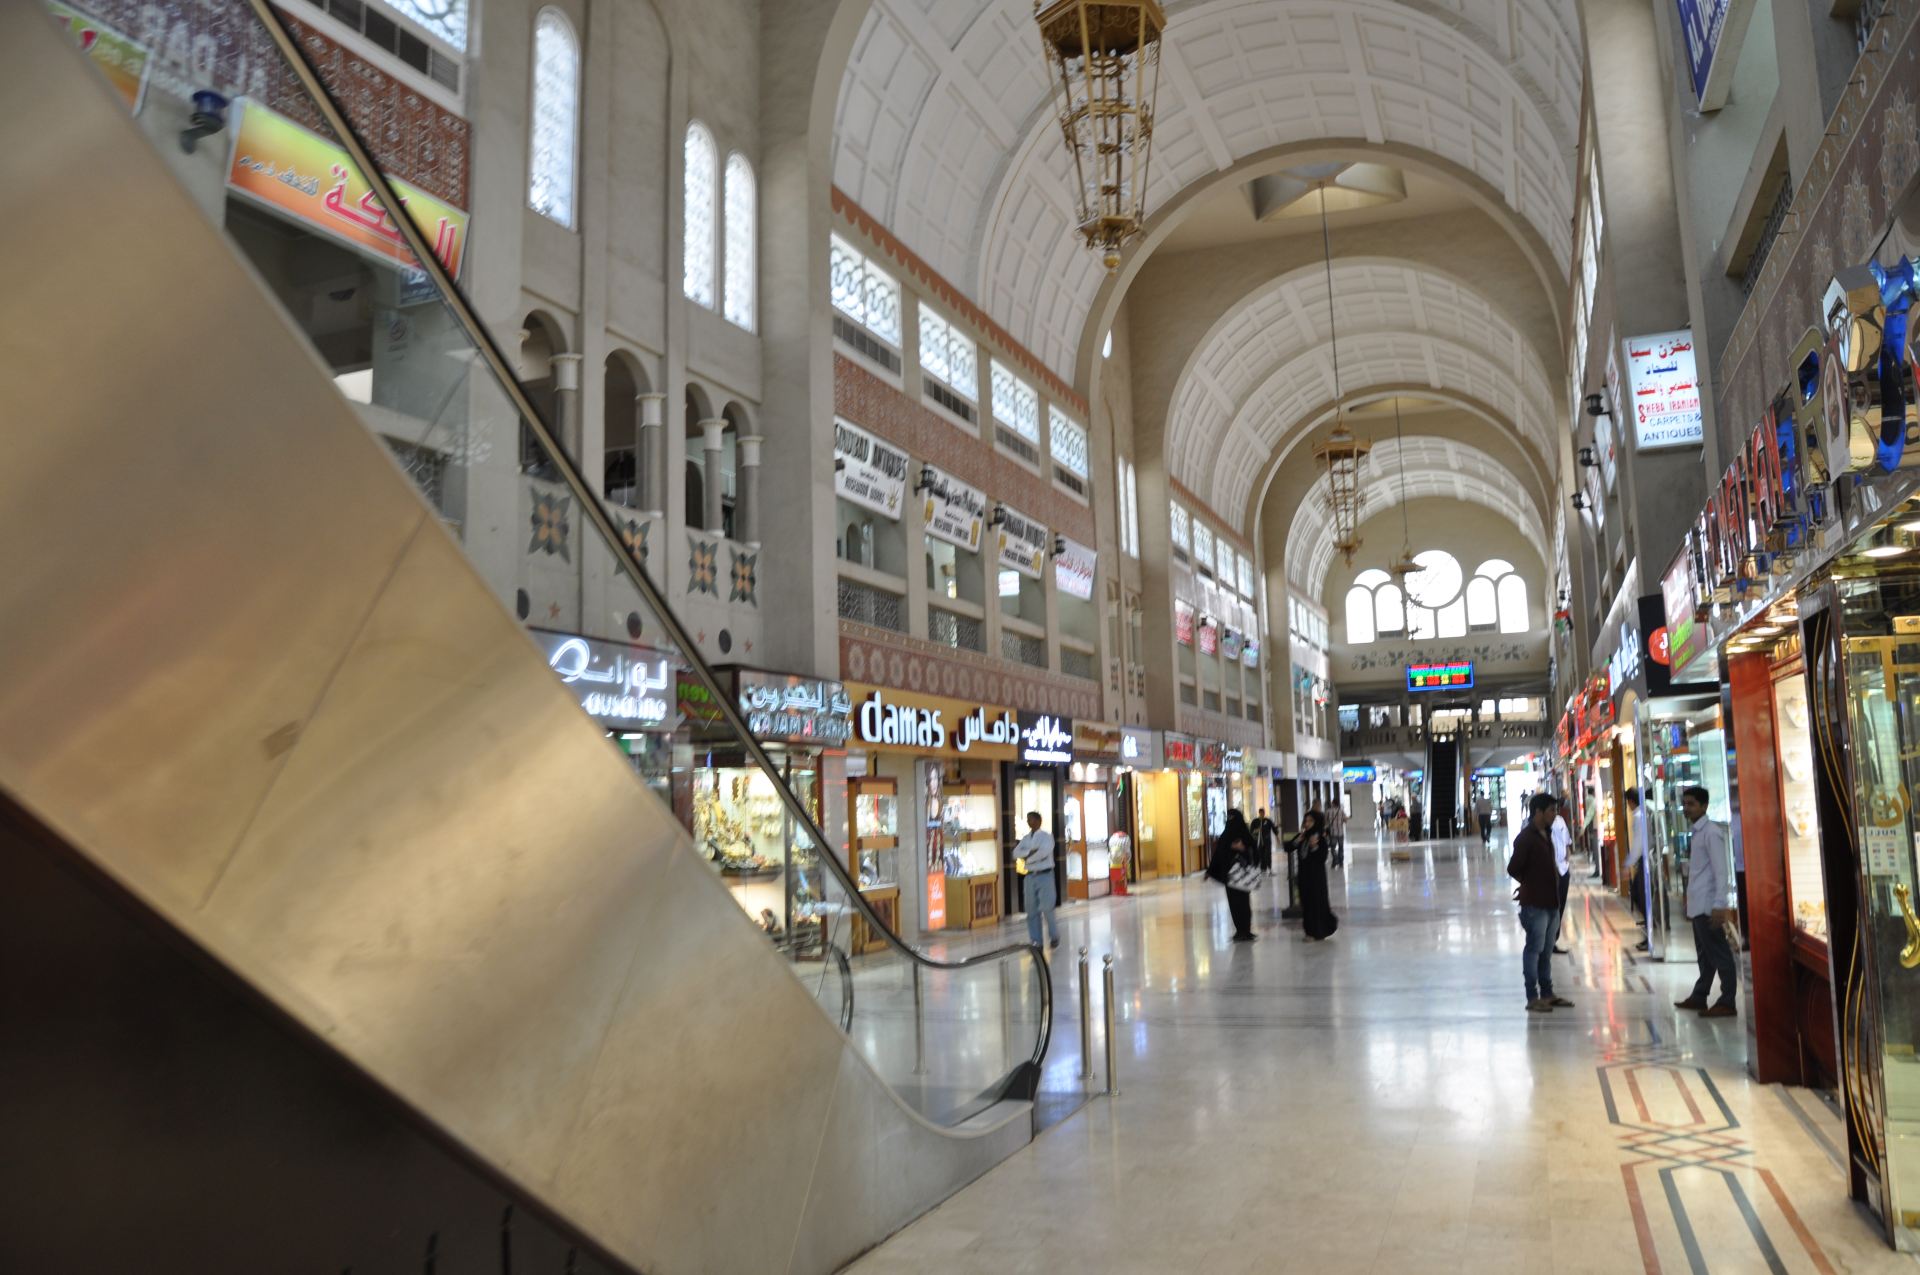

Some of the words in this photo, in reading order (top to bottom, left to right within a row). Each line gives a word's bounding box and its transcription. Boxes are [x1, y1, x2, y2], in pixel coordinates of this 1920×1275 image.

[1658, 338, 1693, 359] مخزن
[1648, 413, 1694, 428] CARPETS
[1643, 424, 1702, 443] ANTIQUES
[581, 691, 668, 721] ausanne
[860, 690, 946, 748] damas
[955, 705, 1020, 753] داماس
